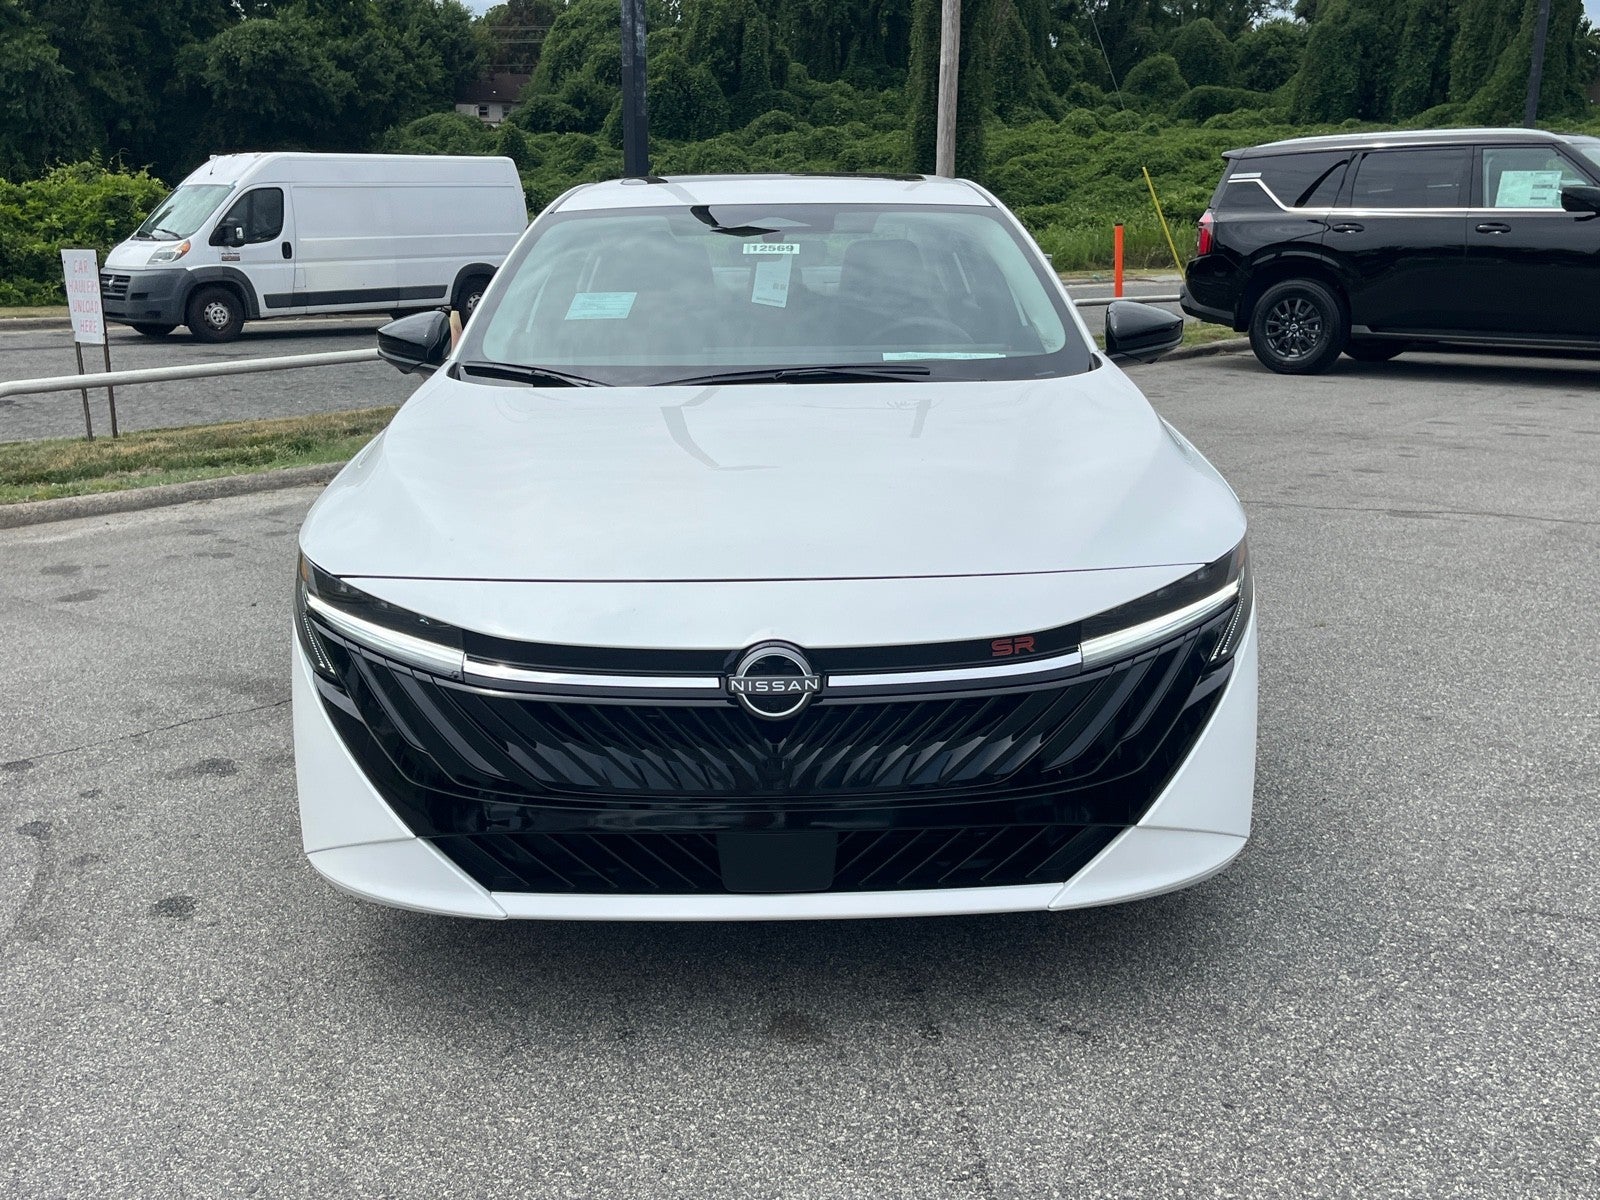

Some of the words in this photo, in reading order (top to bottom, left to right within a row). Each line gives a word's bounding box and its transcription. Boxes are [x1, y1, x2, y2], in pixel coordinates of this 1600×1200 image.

[751, 244, 794, 252] 12569
[73, 259, 89, 274] CAR
[73, 299, 99, 313] UNLOAD
[80, 319, 97, 334] HERE
[991, 635, 1036, 657] SR
[731, 679, 818, 692] NISSAN
